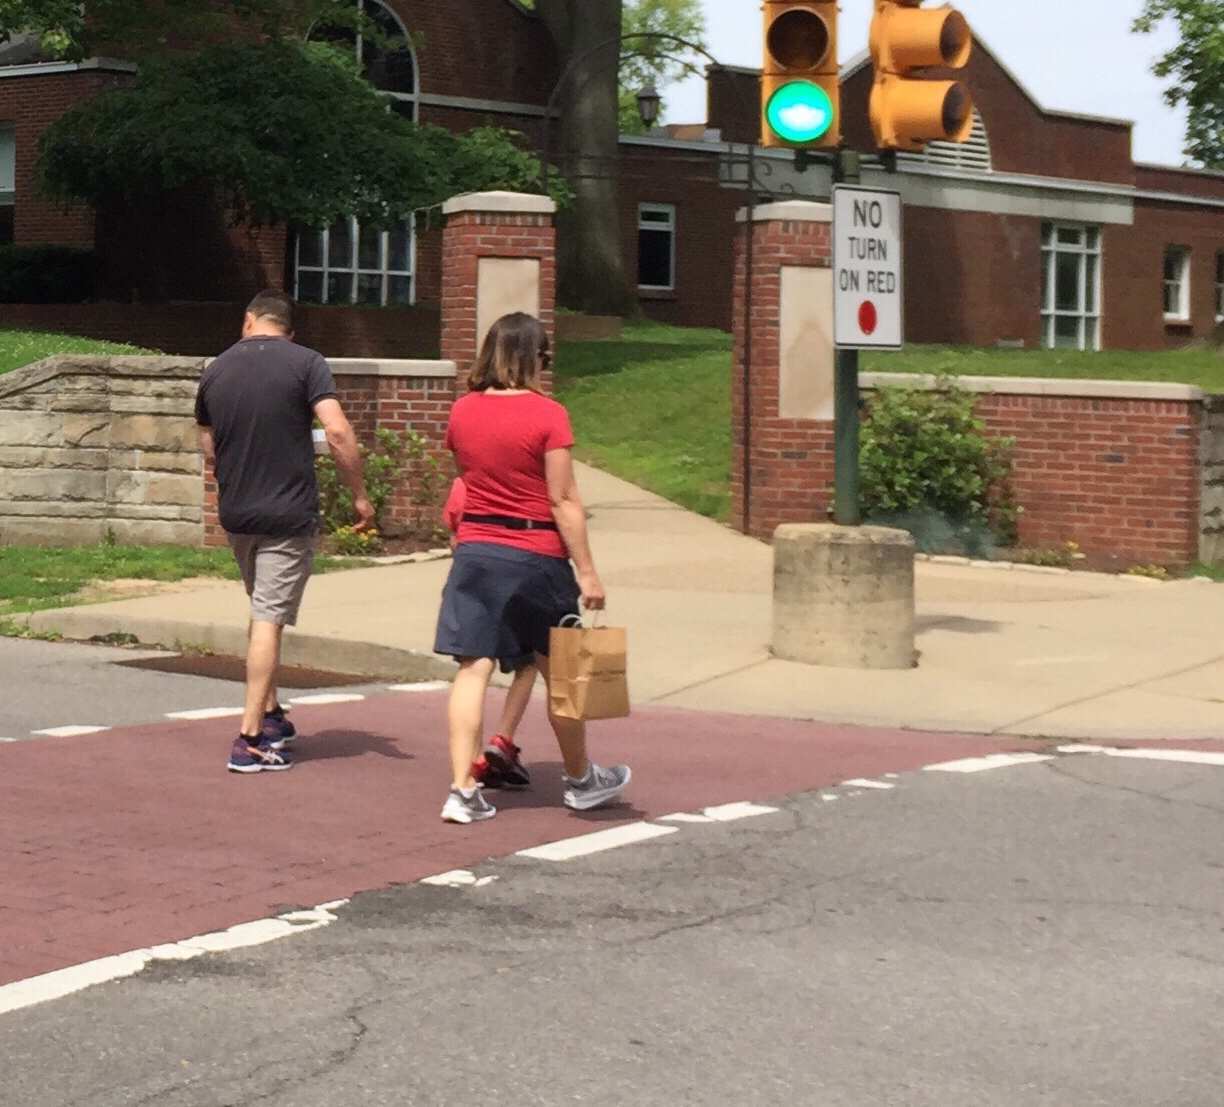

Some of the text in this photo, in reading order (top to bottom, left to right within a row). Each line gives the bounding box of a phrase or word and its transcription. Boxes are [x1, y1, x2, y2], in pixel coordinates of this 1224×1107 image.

[853, 198, 882, 228] NO
[848, 236, 888, 261] TURN
[839, 269, 896, 294] ON RED
